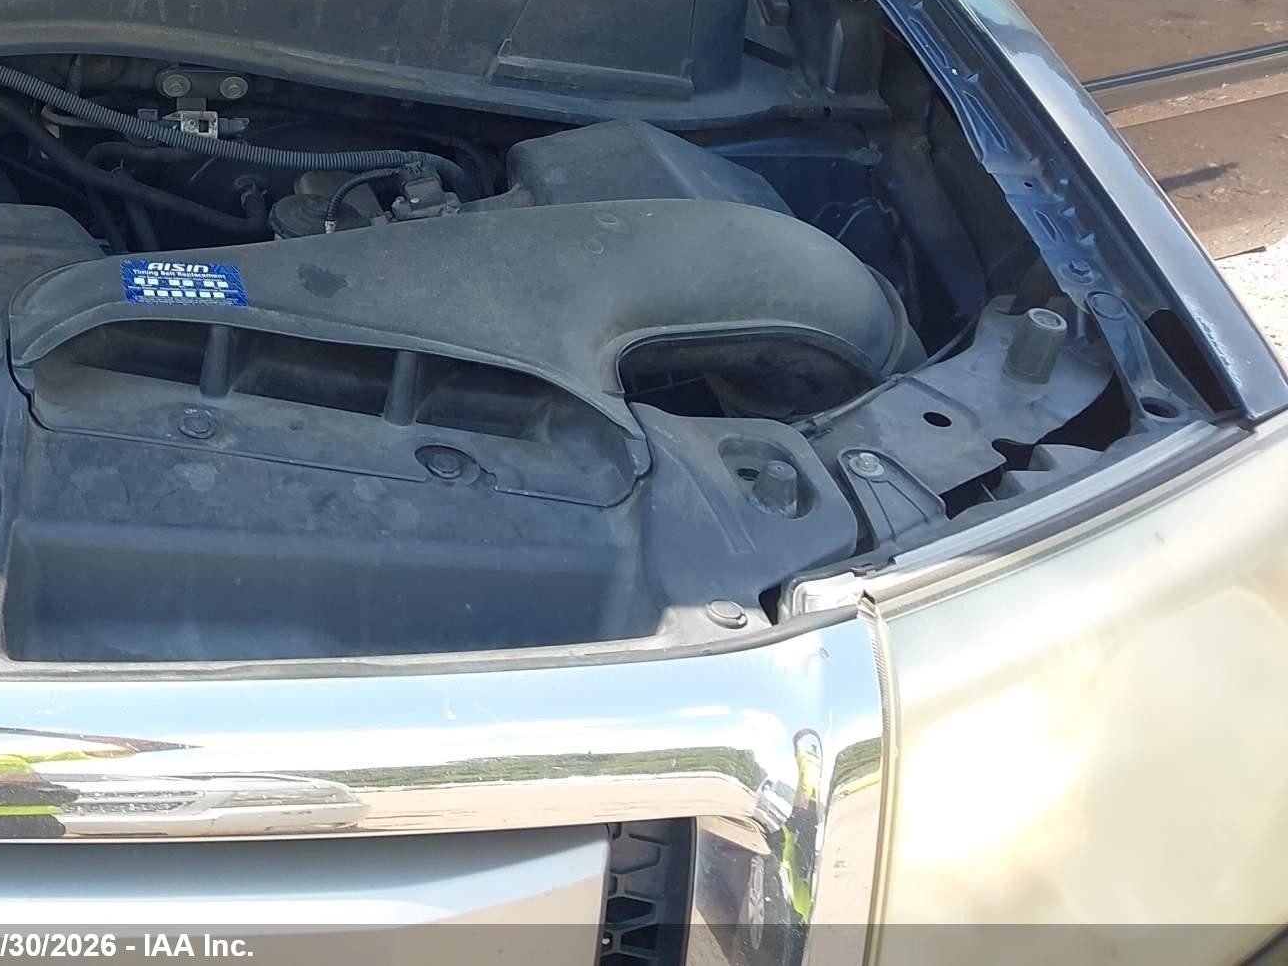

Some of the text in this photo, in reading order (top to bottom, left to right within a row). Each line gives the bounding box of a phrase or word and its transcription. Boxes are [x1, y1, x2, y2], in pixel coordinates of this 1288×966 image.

[148, 262, 209, 273] AISIN
[133, 269, 159, 277] Timing
[177, 271, 226, 279] Replacement
